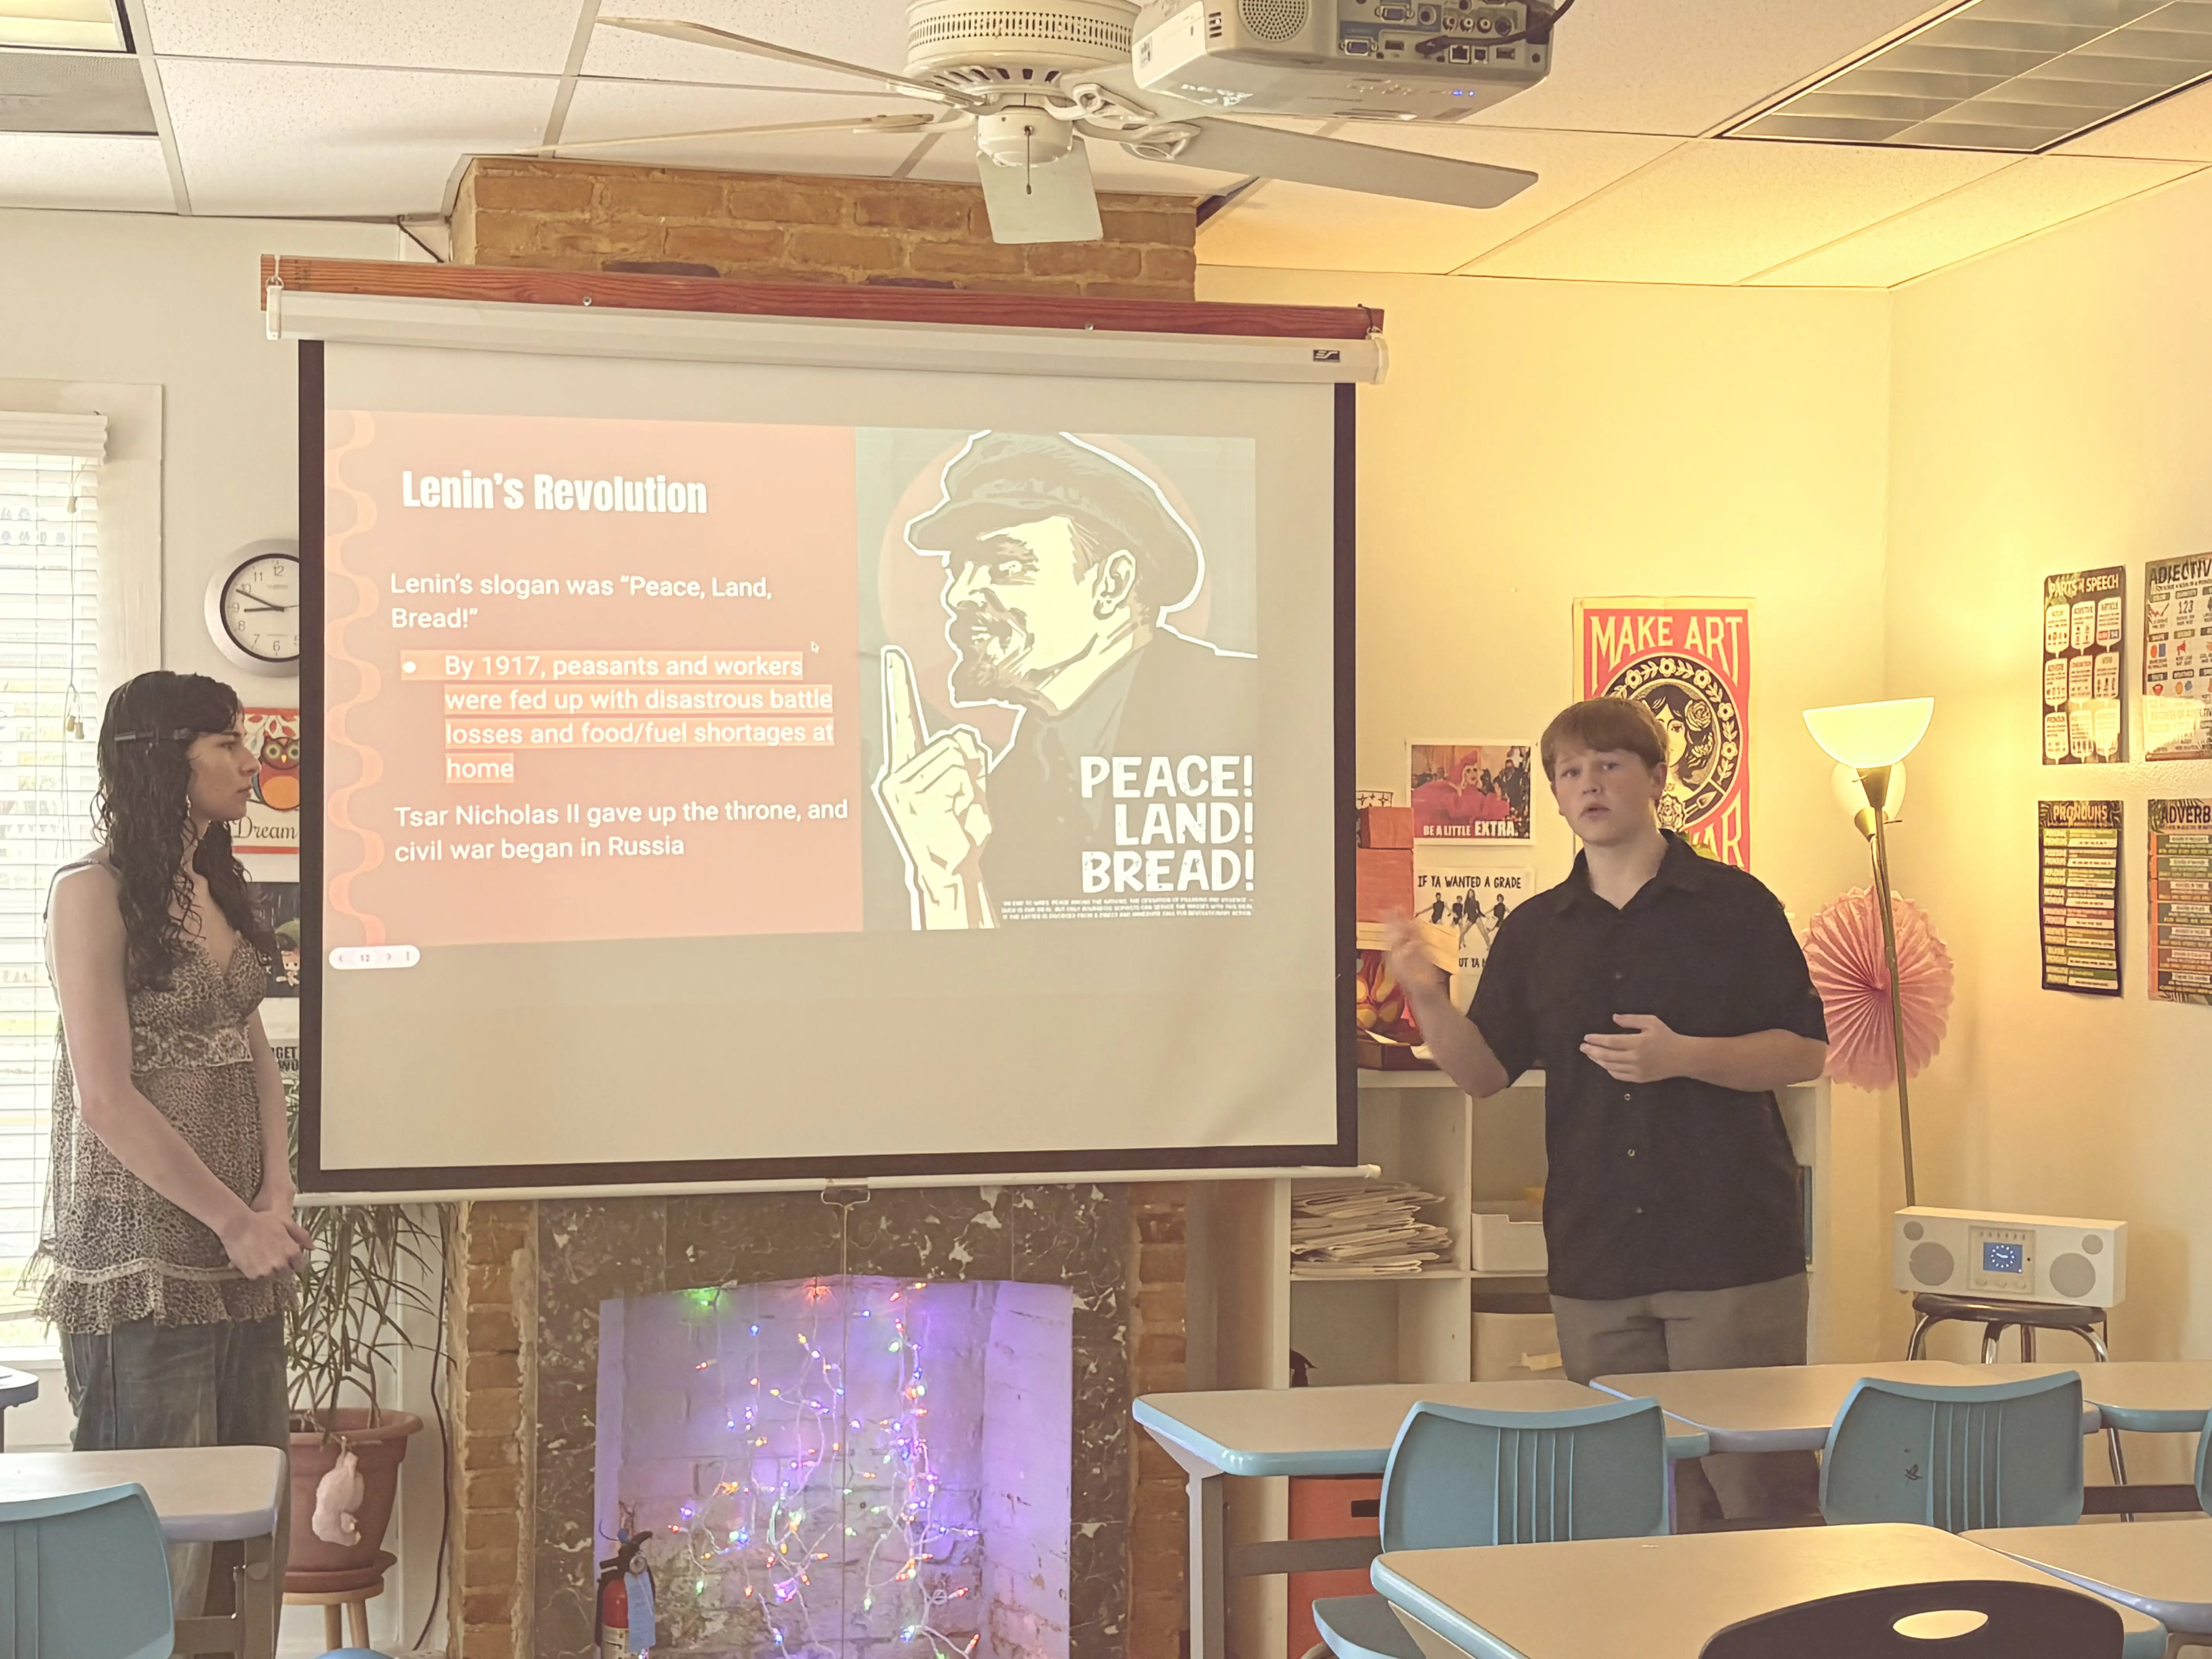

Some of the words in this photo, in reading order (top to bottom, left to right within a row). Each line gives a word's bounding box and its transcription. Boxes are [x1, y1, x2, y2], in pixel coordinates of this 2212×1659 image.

[403, 470, 524, 509] Lenin’s
[534, 474, 707, 513] Revolution
[254, 572, 263, 582] 11
[273, 565, 284, 577] 12
[241, 583, 252, 594] 10
[391, 573, 473, 594] Lenin’s
[481, 574, 559, 599] slogan
[566, 580, 613, 596] was
[621, 575, 705, 599] “Peace,
[712, 577, 772, 599] Land,
[2050, 580, 2077, 598] PARTS
[2086, 573, 2119, 592] SPEECH
[232, 602, 240, 613] 9
[392, 607, 478, 628] Bread!”
[238, 620, 246, 631] 8
[254, 634, 260, 644] 7
[273, 641, 280, 651] 6
[1590, 616, 1673, 695] MAKE
[1684, 616, 1743, 687] ART
[445, 655, 473, 680] By
[482, 656, 546, 679] 1917,
[554, 657, 659, 680] peasants
[666, 655, 707, 675] and
[714, 656, 803, 676] workers
[445, 694, 502, 709] were
[510, 689, 546, 709] fed
[555, 694, 583, 714] up
[590, 688, 638, 709] with
[646, 689, 763, 709] disastrous
[770, 689, 833, 708] battle
[446, 723, 522, 744] losses
[531, 723, 573, 743] and
[581, 722, 686, 743] food/fuel
[695, 722, 805, 746] shortages
[813, 723, 833, 741] at
[447, 758, 514, 778] home
[1080, 754, 1253, 798] PEACE!
[394, 807, 448, 826] Tsar
[456, 804, 559, 825] Nicholas
[567, 804, 579, 823] II
[587, 807, 642, 828] gave
[649, 806, 676, 826] up
[682, 801, 718, 821] the
[725, 800, 801, 822] throne,
[808, 799, 847, 819] and
[1115, 802, 1254, 846] LAND!
[232, 816, 298, 839] Dream
[1423, 825, 1434, 836] BE
[1436, 825, 1442, 836] A
[1444, 825, 1471, 836] LITTLE
[1475, 821, 1518, 836] EXTRA.
[395, 840, 442, 862] civil
[450, 843, 495, 859] war
[501, 838, 573, 863] began
[581, 837, 601, 857] in
[609, 835, 684, 855] Russia
[1082, 849, 1254, 893] BREAD!
[1418, 875, 1428, 887] IF
[1431, 876, 1441, 888] YA
[1444, 876, 1481, 888] WANTED
[1484, 876, 1490, 888] A
[1494, 876, 1521, 889] GRADE
[1471, 958, 1479, 967] YA
